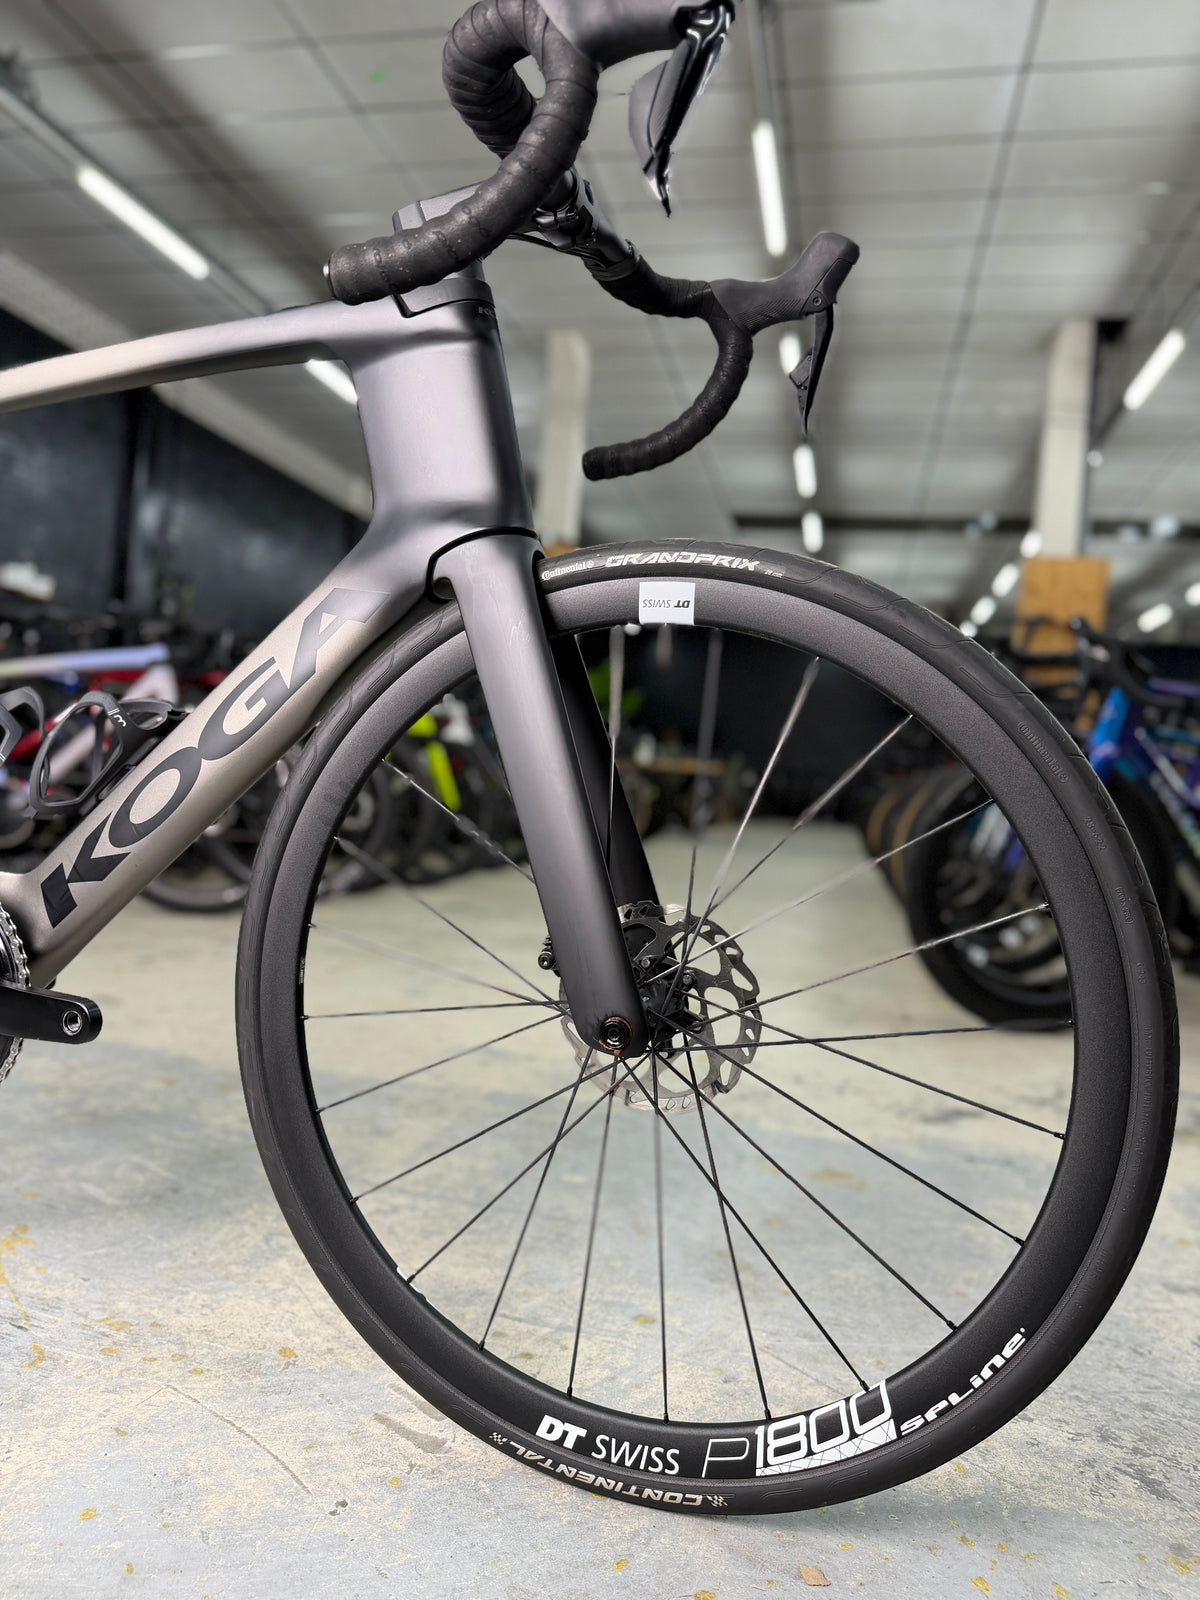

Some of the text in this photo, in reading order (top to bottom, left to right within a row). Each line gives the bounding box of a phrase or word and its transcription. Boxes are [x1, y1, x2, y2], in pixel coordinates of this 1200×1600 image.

[541, 561, 586, 581] Continental
[605, 552, 760, 572] GRANDPRIX
[642, 599, 691, 608] DT SWISS
[40, 587, 391, 929] KOGA
[535, 1414, 588, 1450] DT
[591, 1435, 680, 1475] SWISS
[509, 1440, 703, 1507] CONTINENTAL
